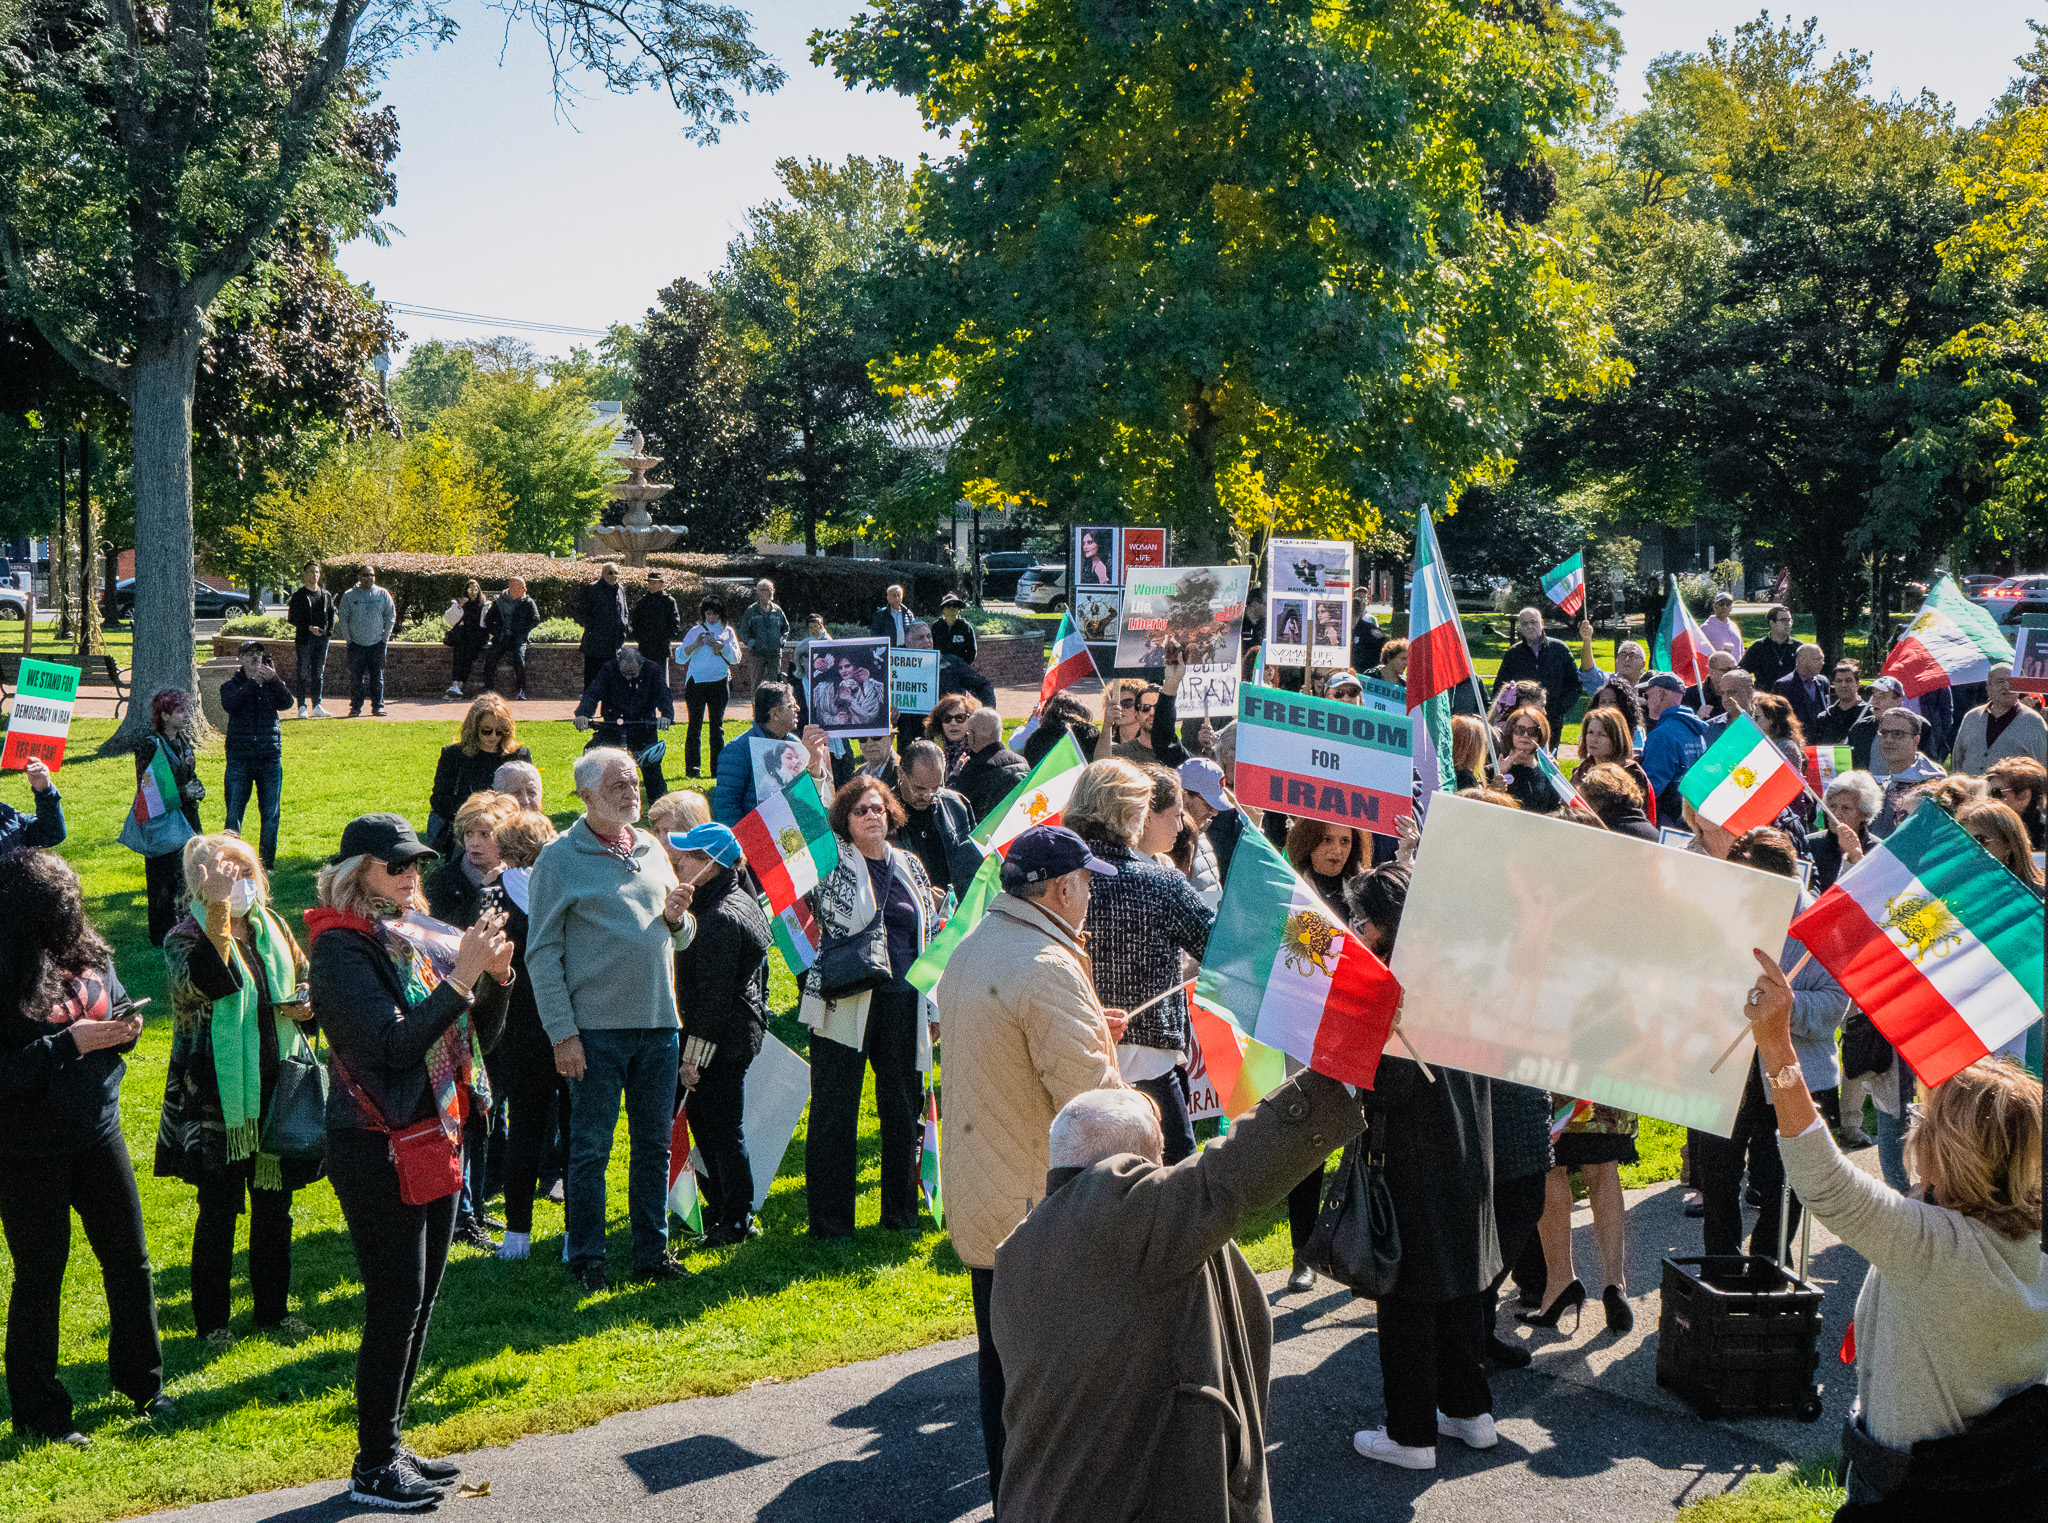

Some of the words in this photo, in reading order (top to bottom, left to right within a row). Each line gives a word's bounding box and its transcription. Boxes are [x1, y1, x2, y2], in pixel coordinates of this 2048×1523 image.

[1134, 584, 1178, 597] Women,
[1131, 600, 1153, 615] Life,
[1128, 618, 1168, 631] Liberty
[1280, 657, 1332, 667] FREOM
[26, 669, 38, 688] WE
[38, 671, 61, 692] STAND
[61, 675, 74, 693] FOR
[892, 670, 898, 679] &
[896, 681, 928, 693] RIGHTS
[1181, 677, 1237, 704] IRAN
[1360, 680, 1406, 702] REEDO
[890, 693, 917, 708] IRAN
[1374, 701, 1387, 712] FOR
[14, 703, 52, 723] DEMOCRACY
[52, 709, 58, 723] IN
[58, 710, 70, 725] IRAN
[1244, 696, 1408, 749] FREEDOM
[16, 740, 29, 758] YES
[1311, 749, 1340, 771] FOR
[1270, 775, 1380, 823] IRAN
